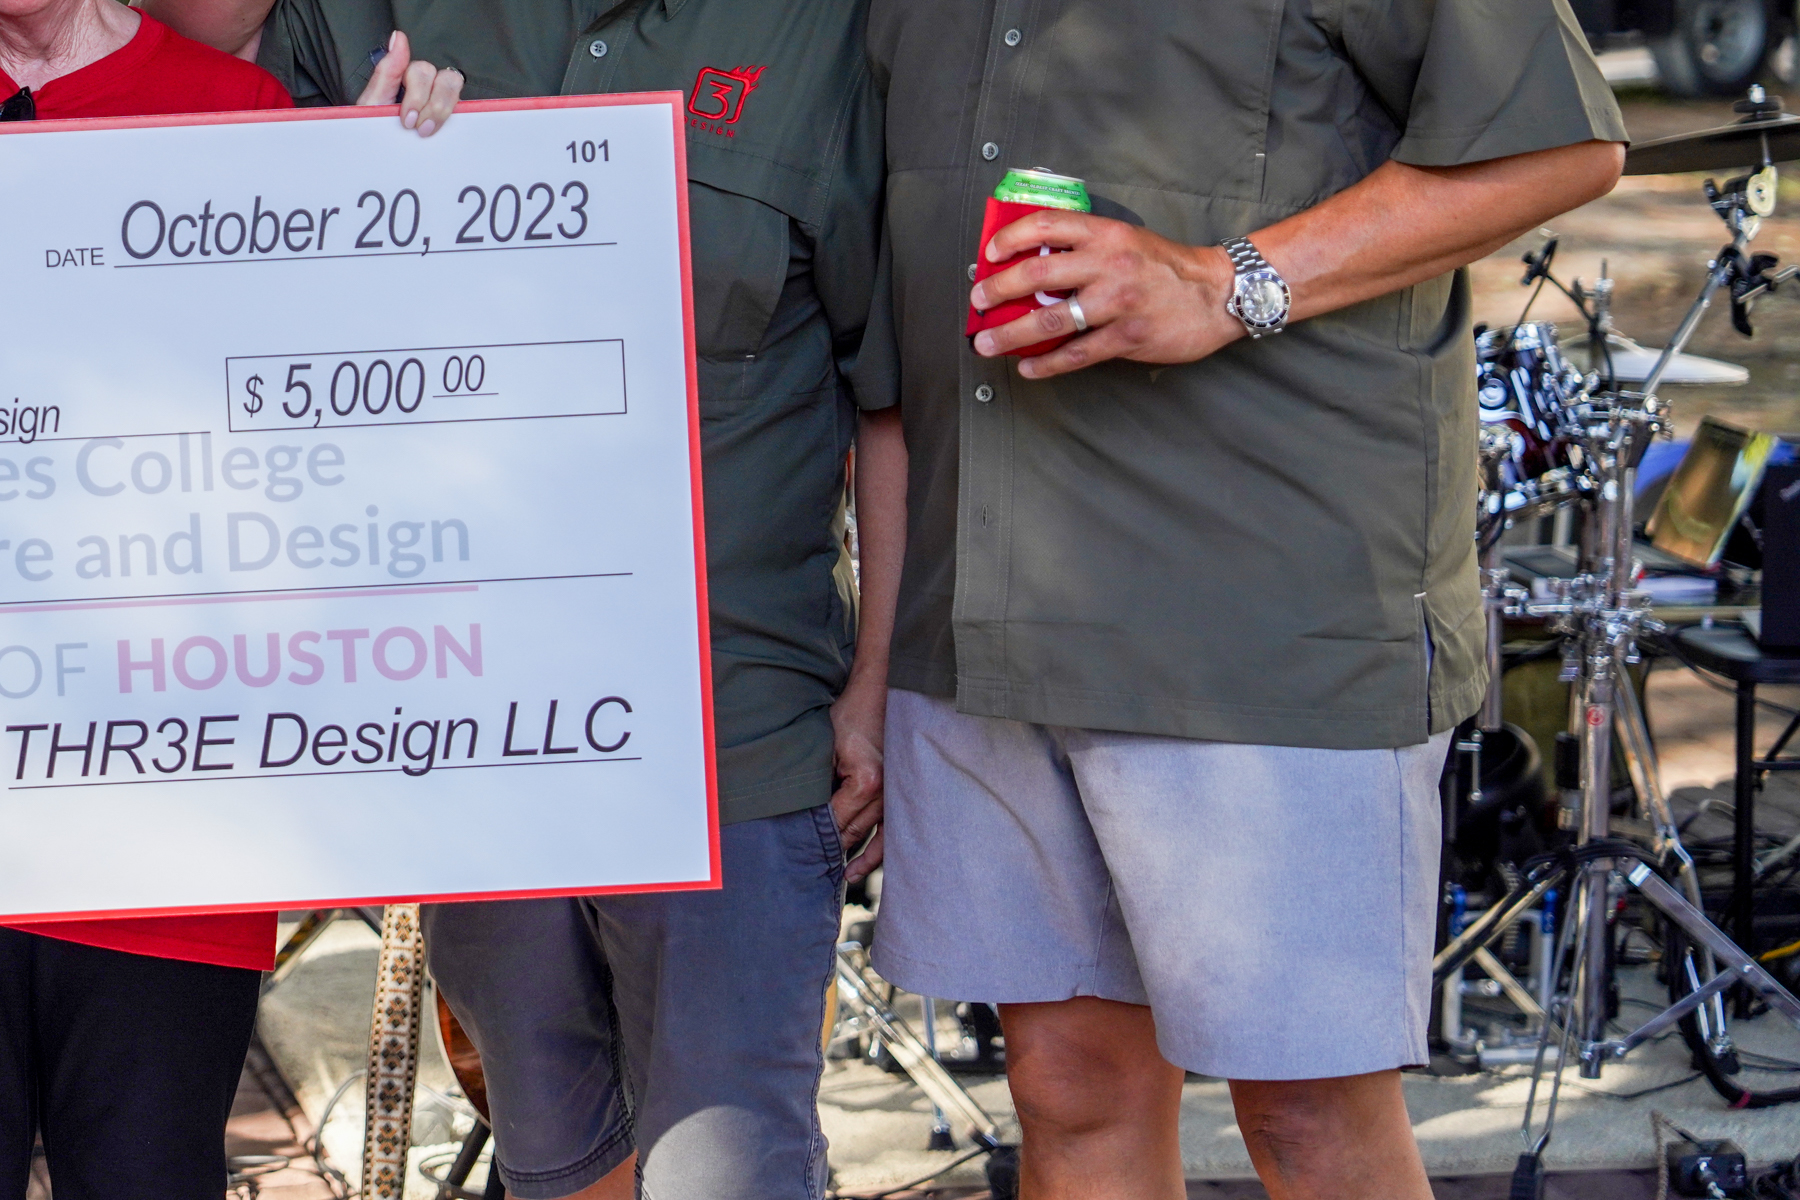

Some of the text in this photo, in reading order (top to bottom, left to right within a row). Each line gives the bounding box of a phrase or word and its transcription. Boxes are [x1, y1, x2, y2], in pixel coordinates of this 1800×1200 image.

[566, 139, 609, 163] 101
[46, 181, 588, 267] DATE October 20, 2023
[243, 355, 485, 428] $ 5,000 00
[75, 432, 346, 502] College
[74, 512, 204, 580] and
[227, 504, 471, 579] Design
[117, 623, 484, 694] HOUSTON
[6, 696, 632, 780] THR3E Design LLC
